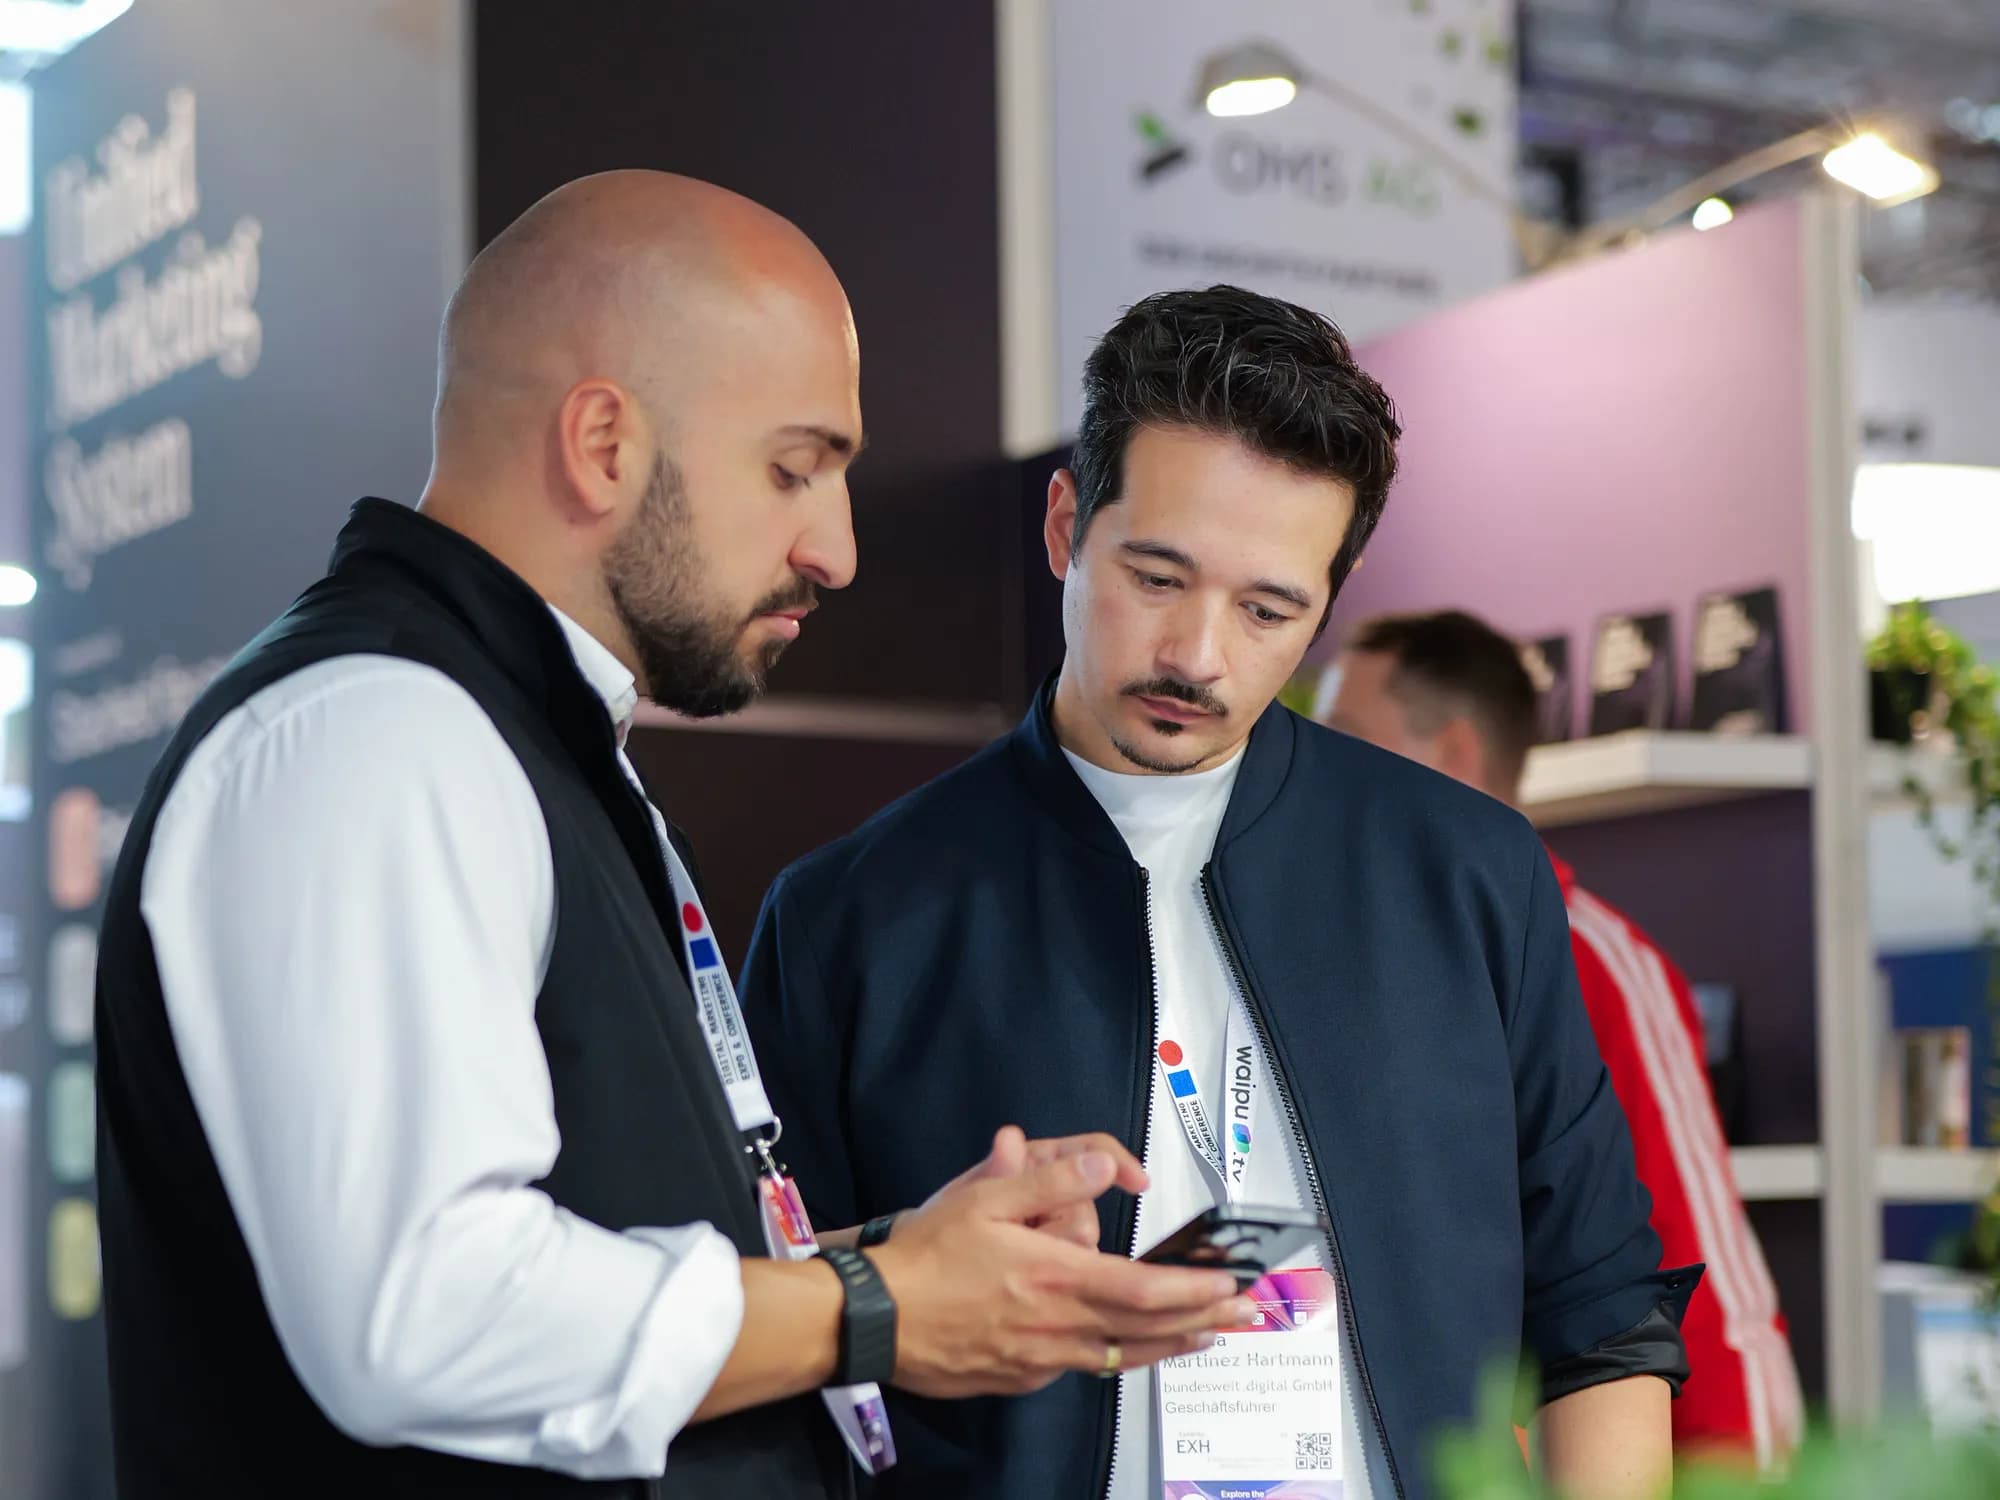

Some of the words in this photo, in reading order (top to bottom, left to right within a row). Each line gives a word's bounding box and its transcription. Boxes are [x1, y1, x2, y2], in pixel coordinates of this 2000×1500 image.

[698, 976, 719, 1035] MARKETING
[712, 973, 737, 1037] CONFERENCE
[714, 1040, 734, 1085] DIGITAL
[735, 1054, 750, 1080] EXPO
[1231, 1046, 1257, 1119] waipu
[1178, 1103, 1204, 1149] MARKETING
[1190, 1100, 1217, 1152] CONFERENCE
[1163, 1353, 1240, 1368] Martinez
[1247, 1352, 1333, 1367] Hartmann
[1292, 1379, 1332, 1392] GmbH
[1176, 1440, 1210, 1454] EXH
[1221, 1490, 1250, 1499] Explore
[1251, 1490, 1264, 1498] the
